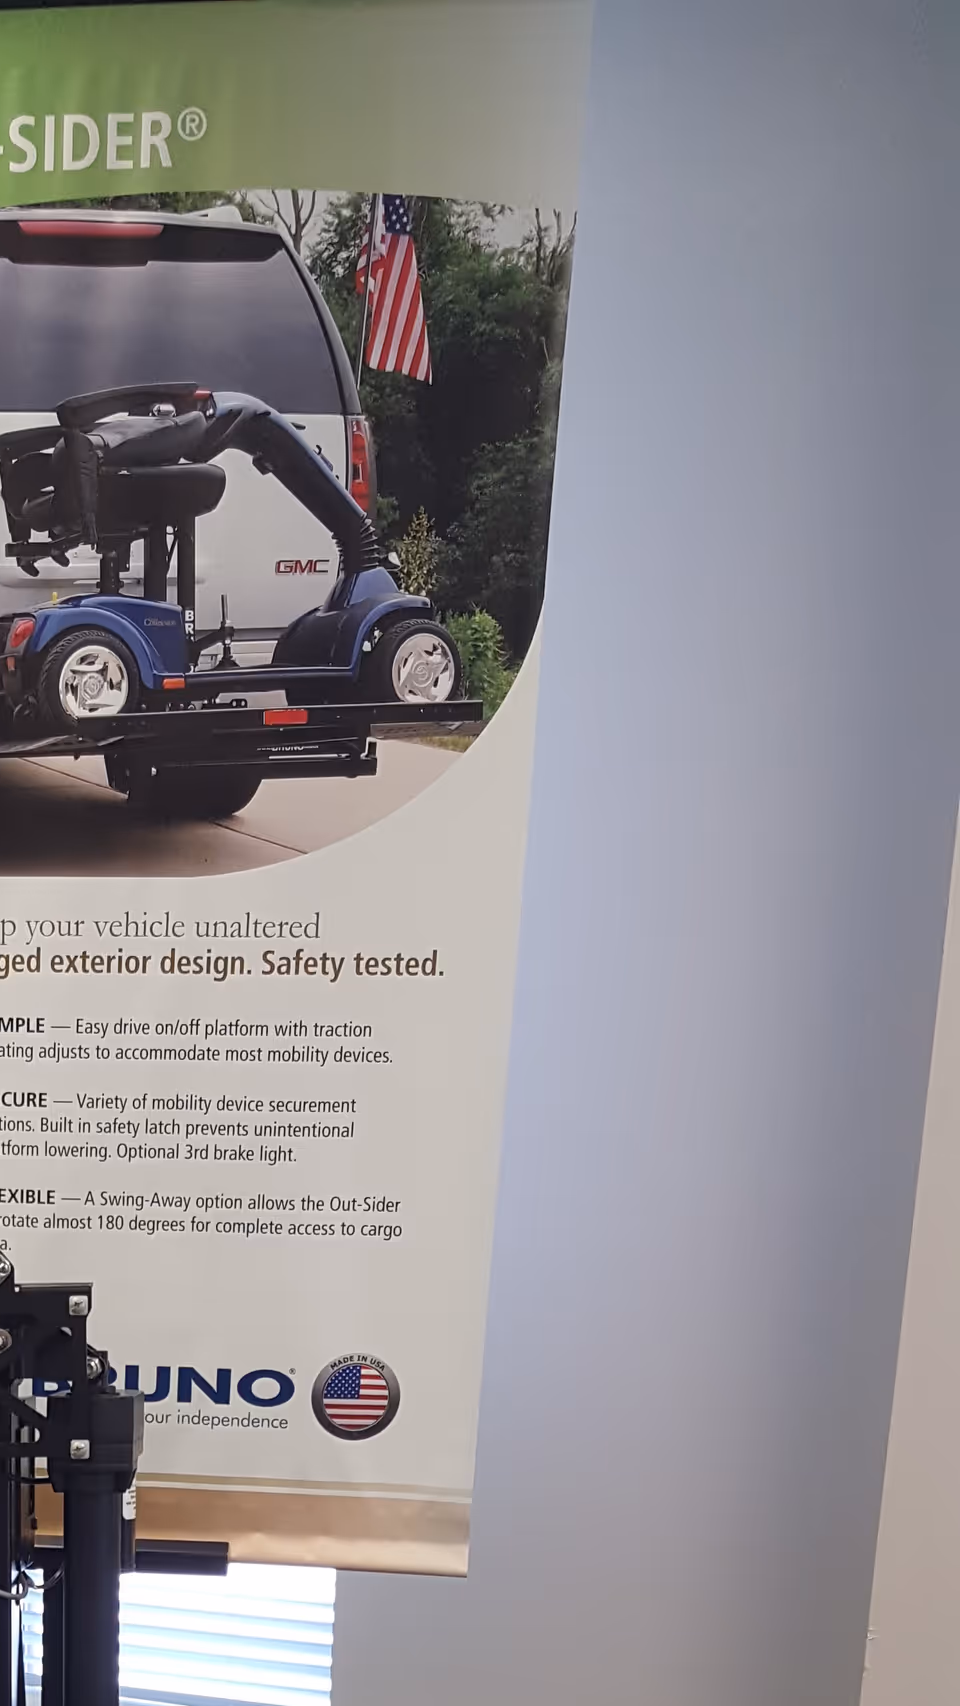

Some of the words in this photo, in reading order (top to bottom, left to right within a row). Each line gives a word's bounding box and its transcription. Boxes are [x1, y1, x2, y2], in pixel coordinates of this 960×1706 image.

[275, 559, 330, 574] GMC
[26, 920, 84, 945] your
[93, 911, 184, 937] vehicle
[195, 912, 320, 938] unaltered
[51, 948, 151, 974] exterior
[160, 948, 251, 982] design.
[262, 949, 345, 983] Safety
[354, 950, 444, 976] tested.
[76, 1019, 109, 1038] Easy
[114, 1018, 150, 1035] drive
[155, 1018, 201, 1035] on/off
[205, 1019, 268, 1040] platform
[275, 1020, 307, 1037] with
[313, 1021, 371, 1037] traction
[39, 1042, 90, 1063] adjusts
[96, 1045, 110, 1059] to
[116, 1044, 220, 1061] accommodate
[226, 1048, 262, 1061] most
[268, 1046, 329, 1067] mobility
[334, 1046, 392, 1063] devices.
[77, 1093, 127, 1113] Variety
[133, 1093, 148, 1109] of
[152, 1094, 211, 1115] mobility
[217, 1095, 263, 1112] device
[269, 1099, 356, 1113] securement
[41, 1117, 73, 1133] Built
[79, 1118, 90, 1133] in
[96, 1117, 140, 1138] safety
[145, 1118, 180, 1135] latch
[186, 1122, 248, 1139] prevents
[255, 1121, 354, 1137] unintentional
[45, 1141, 111, 1162] lowering.
[117, 1143, 179, 1162] Optional
[185, 1144, 208, 1159] 3rd
[214, 1144, 254, 1161] brake
[260, 1145, 296, 1166] light.
[84, 1191, 95, 1205] A
[100, 1191, 191, 1212] Swing-Away
[196, 1193, 242, 1212] option
[248, 1194, 295, 1210] allows
[301, 1195, 324, 1211] the
[330, 1196, 401, 1212] Out-Sider
[44, 1213, 92, 1229] almost
[98, 1215, 124, 1230] 180
[129, 1215, 185, 1235] degrees
[191, 1216, 211, 1232] for
[216, 1218, 282, 1238] complete
[288, 1224, 335, 1235] access
[341, 1222, 355, 1236] to
[361, 1225, 402, 1241] cargo
[330, 1355, 355, 1370] MADE
[369, 1358, 385, 1371] USA
[177, 1409, 289, 1429] independence
